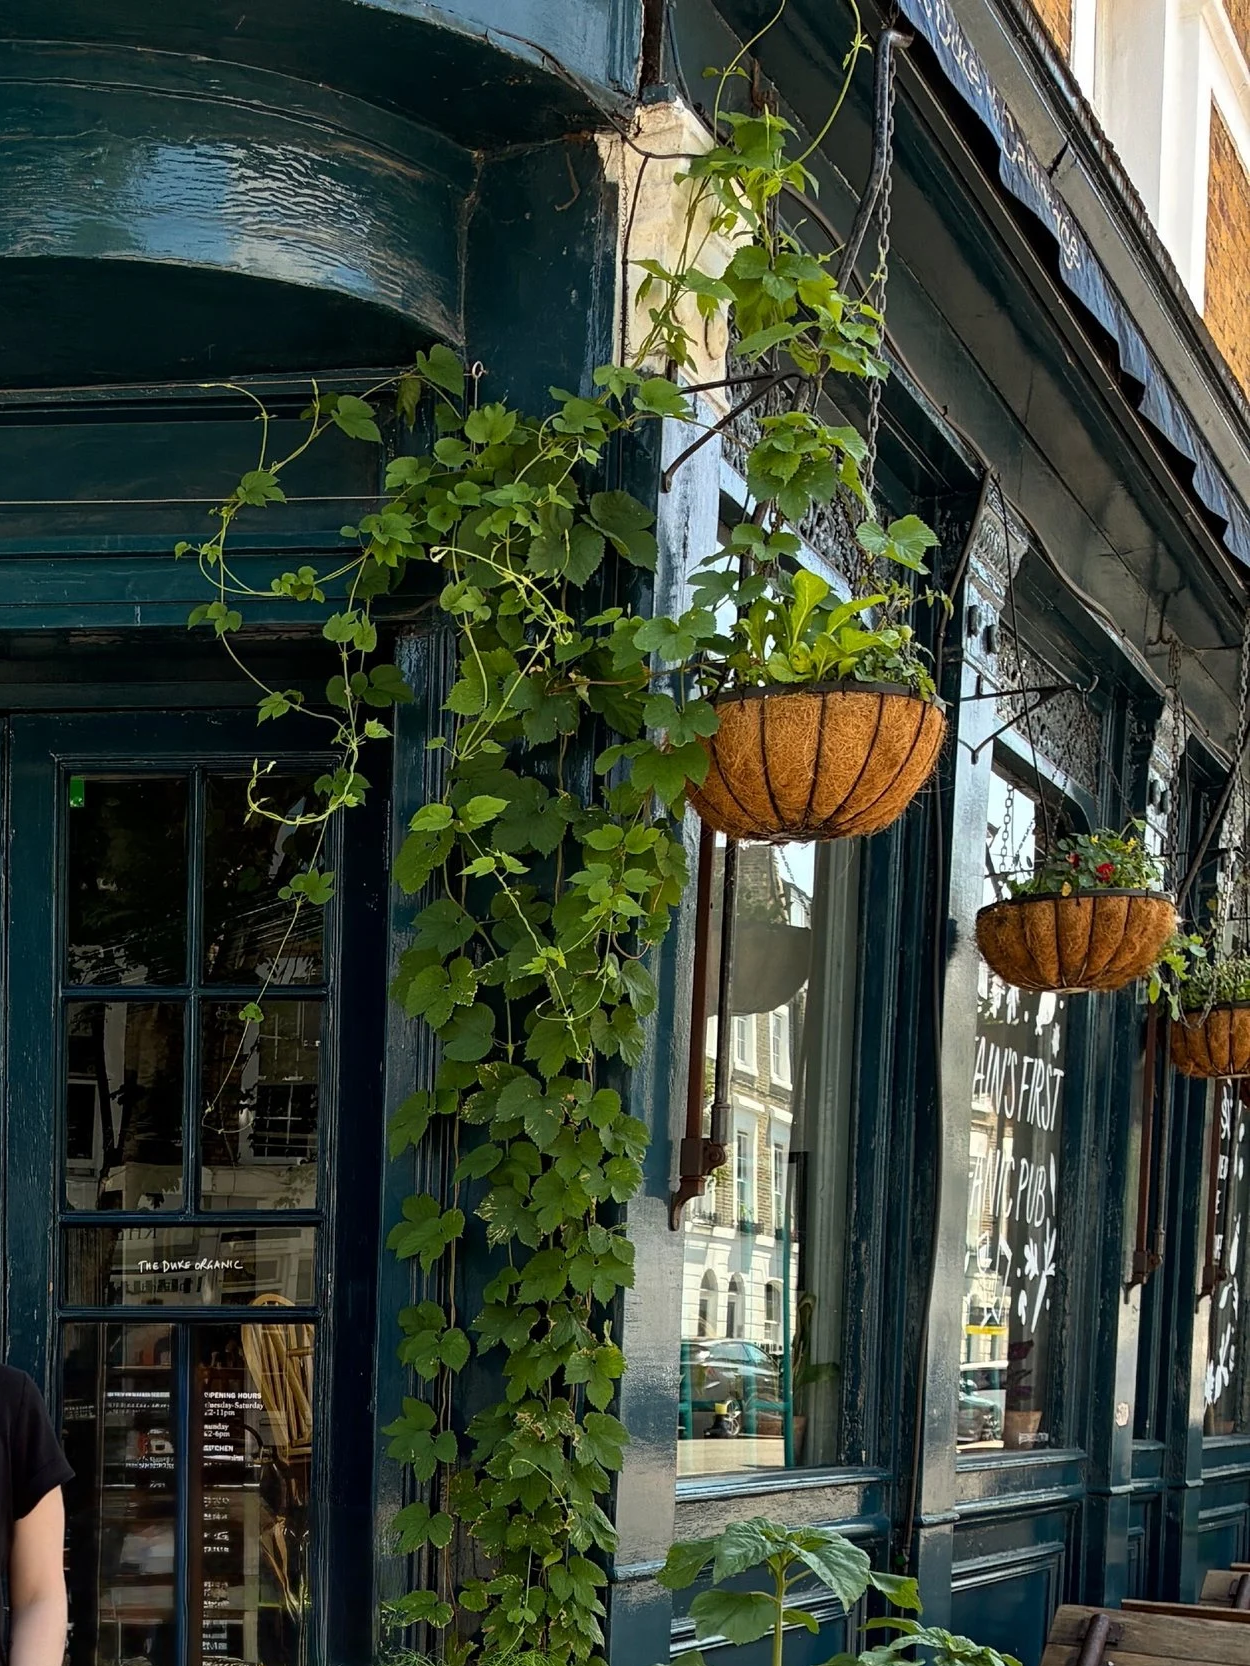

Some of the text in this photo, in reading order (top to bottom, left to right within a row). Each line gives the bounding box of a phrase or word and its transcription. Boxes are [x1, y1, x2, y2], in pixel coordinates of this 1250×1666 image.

[972, 1036, 1065, 1132] AIN'S FIRST
[968, 1147, 1047, 1228] ANIC PUB
[138, 1257, 244, 1273] THE DUKE ORGANIC
